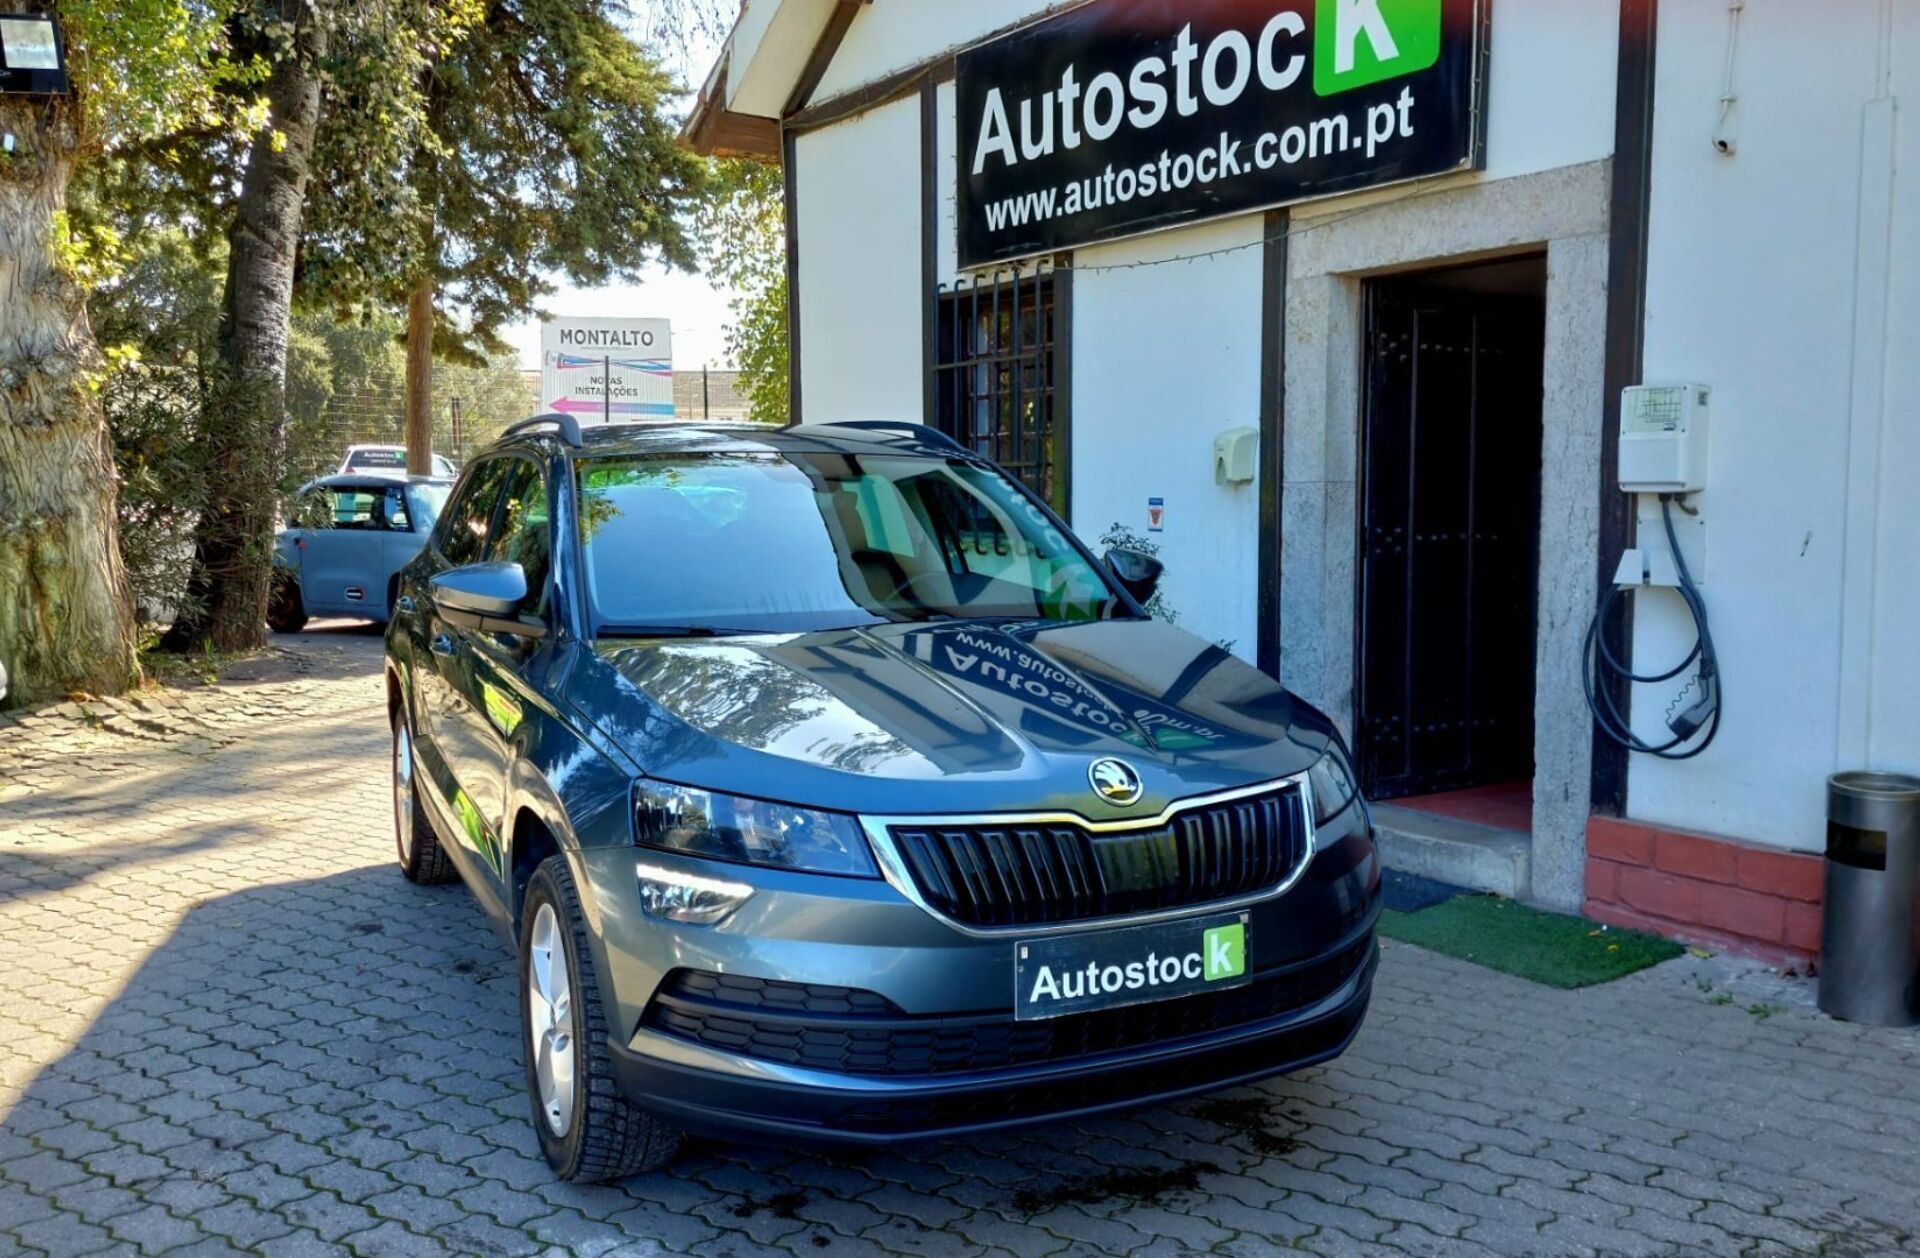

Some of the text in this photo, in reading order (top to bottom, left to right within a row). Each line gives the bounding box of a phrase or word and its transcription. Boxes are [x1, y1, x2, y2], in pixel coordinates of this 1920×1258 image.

[972, 0, 1400, 176] Autostock
[984, 85, 1416, 233] www.autostock.com.pt
[560, 329, 654, 346] MONTALTO
[590, 376, 623, 385] NOAS
[1030, 934, 1233, 1003] Autostock
